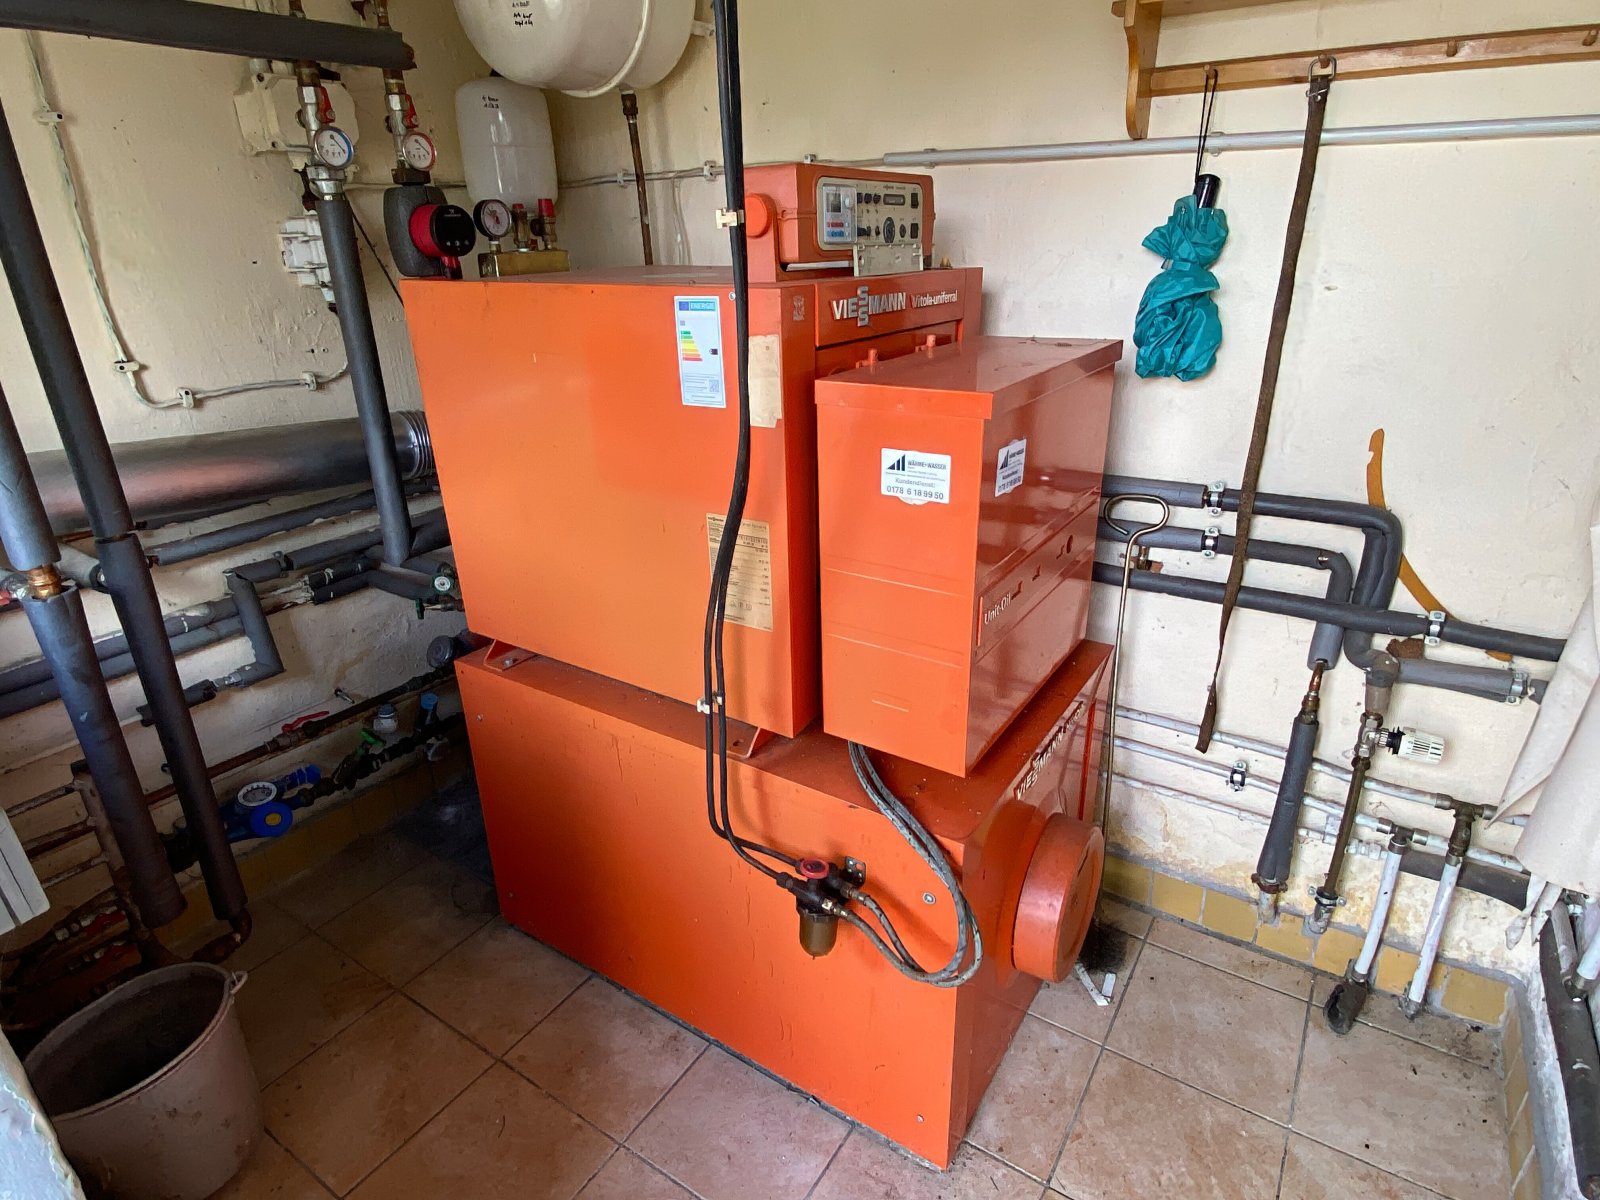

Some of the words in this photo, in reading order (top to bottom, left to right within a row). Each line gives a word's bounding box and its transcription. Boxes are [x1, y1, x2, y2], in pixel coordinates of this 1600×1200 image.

[832, 286, 906, 327] VIESSMANN
[911, 290, 958, 309] Vitola-uniferral
[886, 485, 904, 494] 0178
